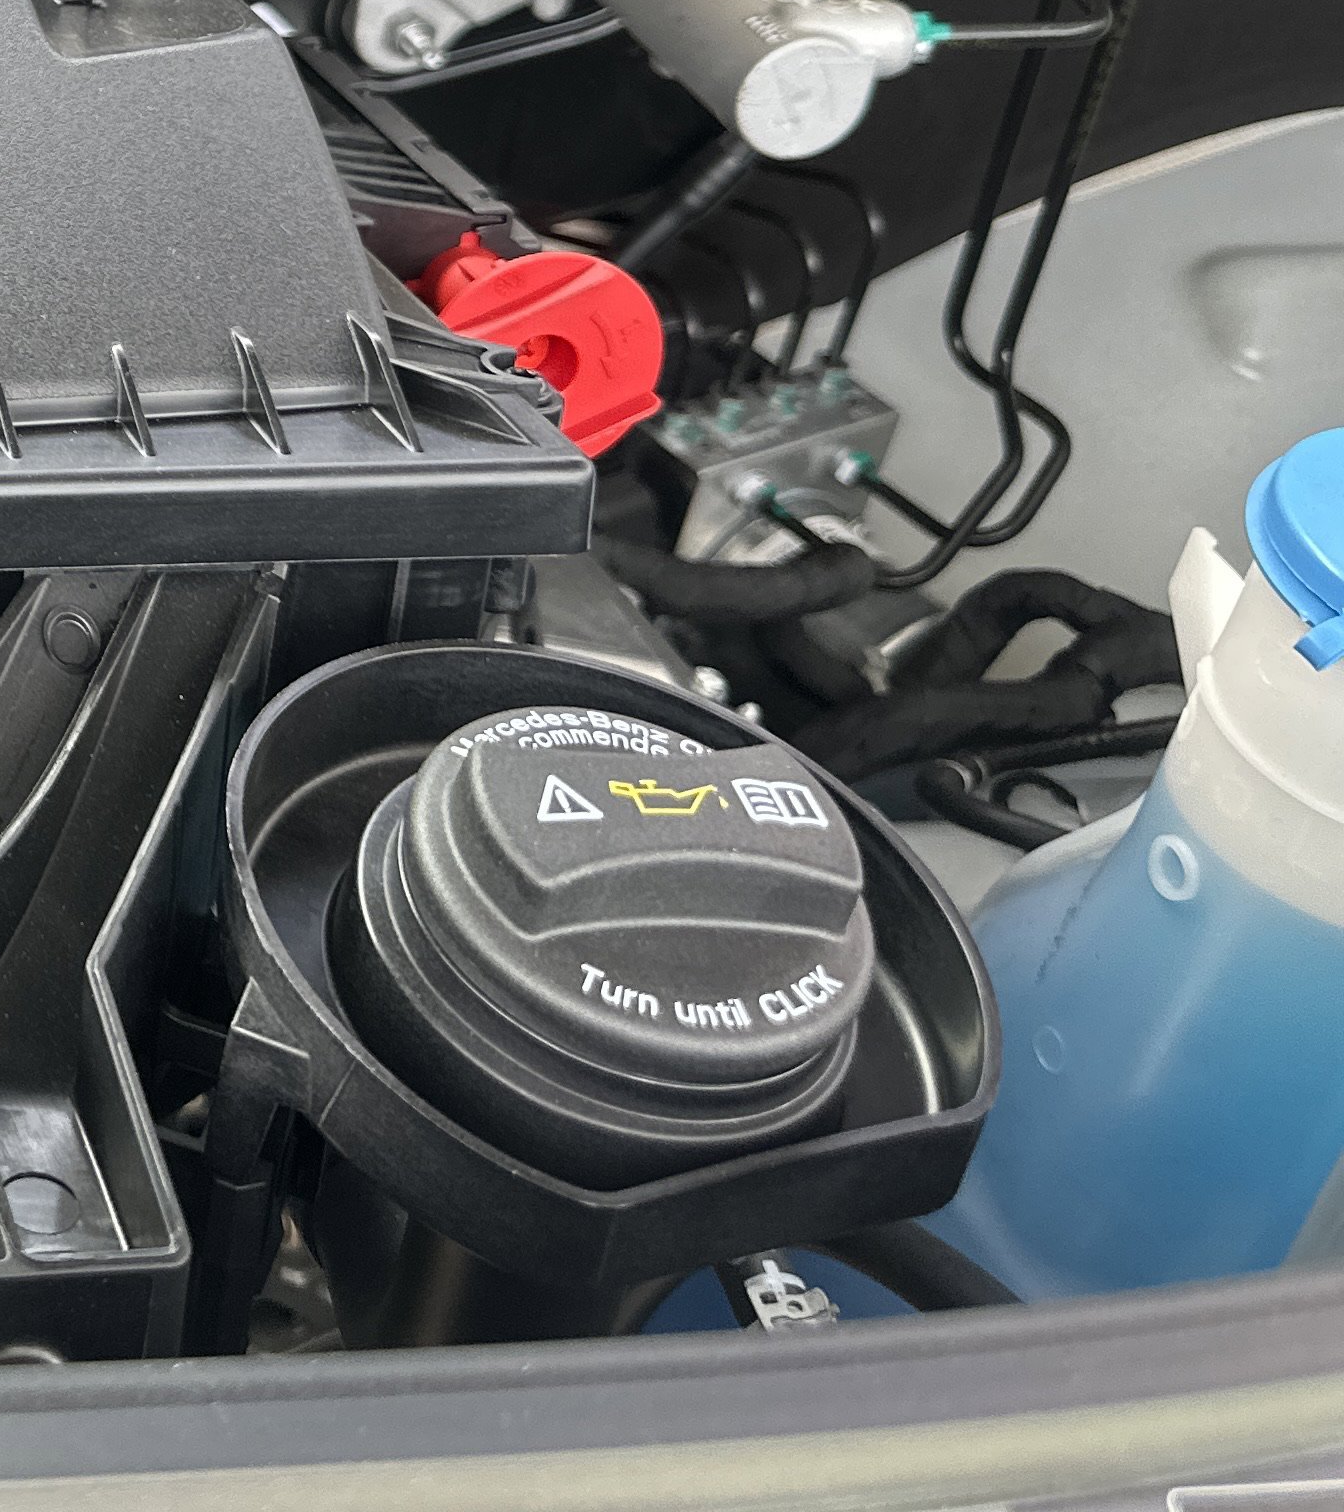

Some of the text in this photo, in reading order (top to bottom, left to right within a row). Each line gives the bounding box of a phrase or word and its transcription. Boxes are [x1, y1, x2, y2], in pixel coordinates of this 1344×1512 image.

[580, 963, 844, 1030] Turn until CLICK
